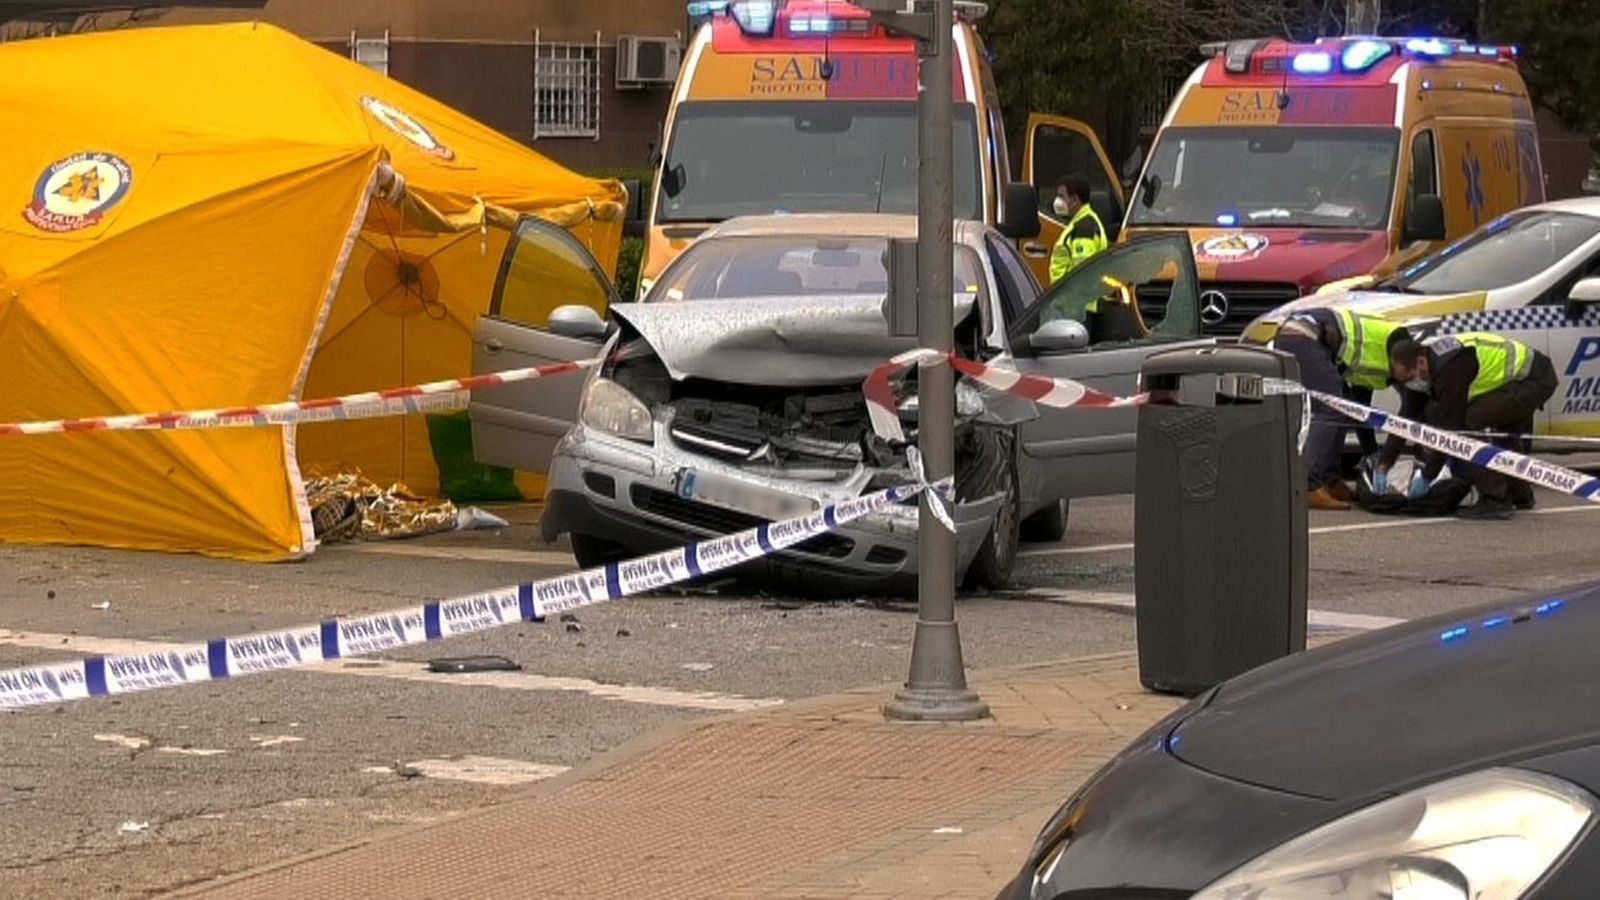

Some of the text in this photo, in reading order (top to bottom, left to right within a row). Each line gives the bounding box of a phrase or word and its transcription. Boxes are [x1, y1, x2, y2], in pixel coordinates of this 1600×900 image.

[1422, 429, 1437, 445] NO
[1438, 436, 1472, 458] PASAR
[1526, 466, 1543, 479] NO
[1543, 471, 1576, 490] PASAR
[535, 581, 565, 601] PASAR
[442, 600, 474, 620] PASAR
[473, 596, 488, 613] NO
[340, 619, 376, 640] PASAR
[373, 615, 392, 635] NO
[229, 638, 267, 659] PASAR
[265, 635, 285, 654] NO
[108, 656, 149, 679] PASAR
[149, 653, 169, 670] NO
[20, 669, 43, 691] NO
